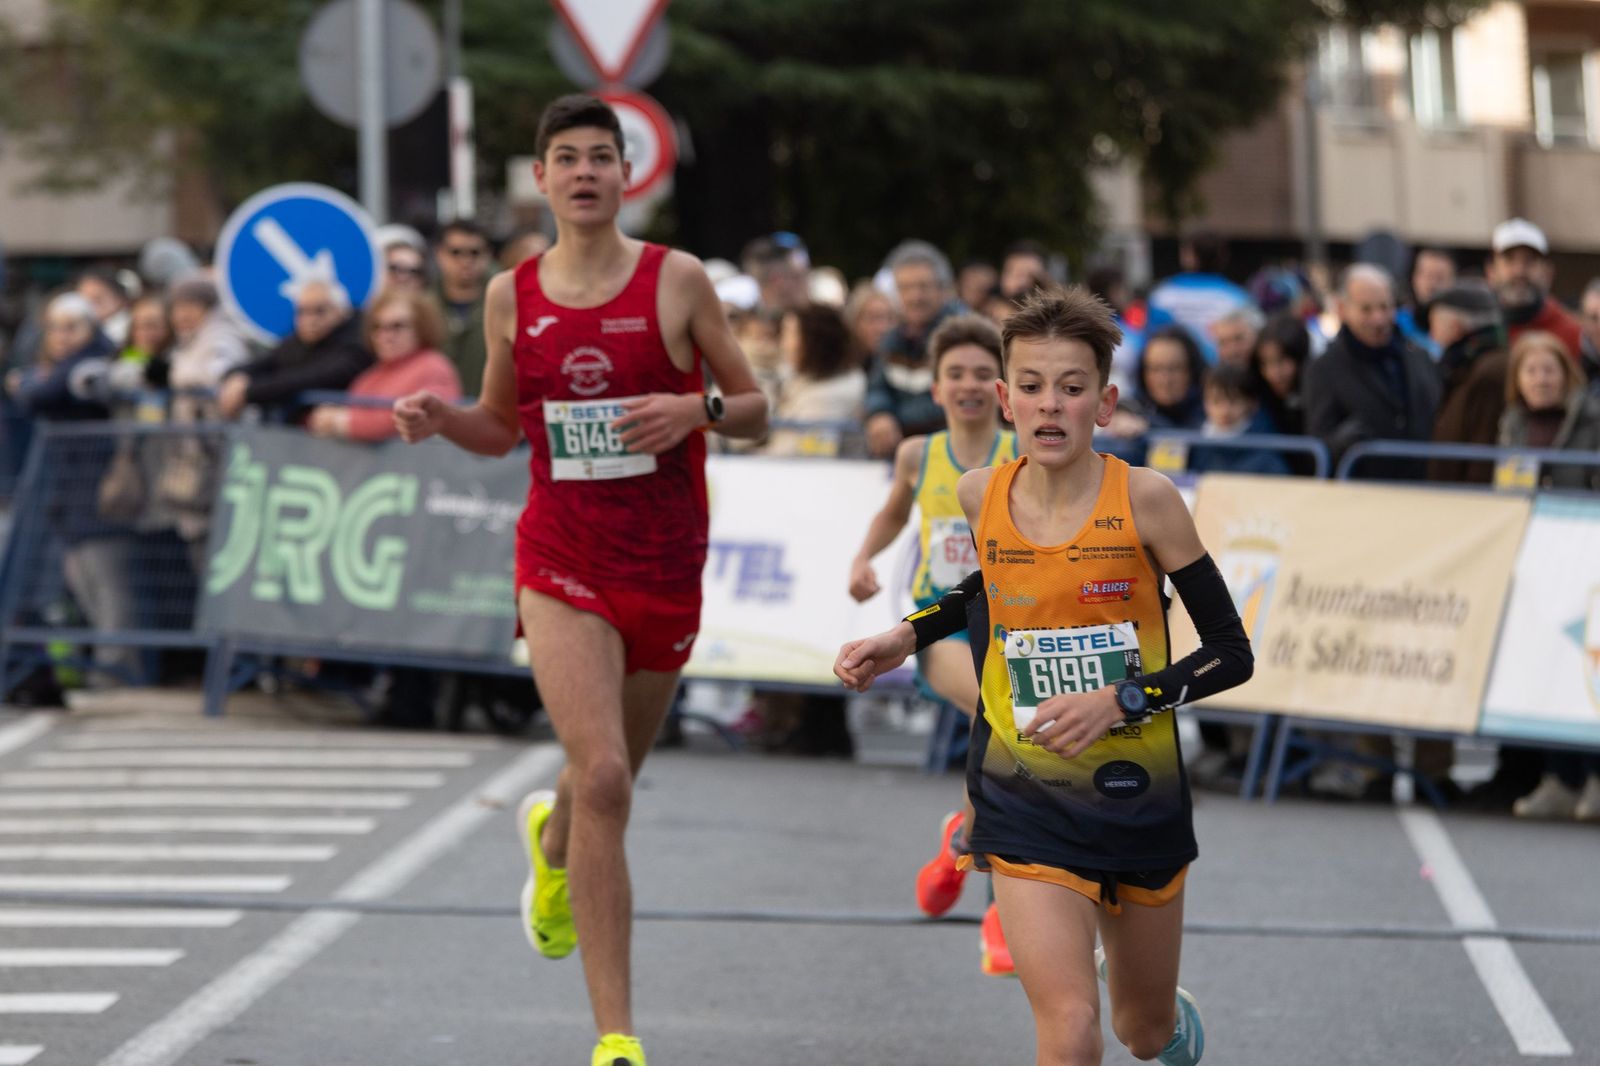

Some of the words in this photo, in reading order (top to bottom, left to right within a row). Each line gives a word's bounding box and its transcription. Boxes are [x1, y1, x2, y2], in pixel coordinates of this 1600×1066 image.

[571, 405, 624, 419] SETE
[708, 541, 793, 583] TEL
[1006, 557, 1035, 565] Salamanca
[1102, 582, 1129, 593] ELICES
[1284, 570, 1470, 628] Ayuntamiento
[1038, 632, 1125, 653] SETEL
[1269, 628, 1298, 670] de
[1306, 630, 1456, 686] Salamanca
[1029, 655, 1105, 698] 6199
